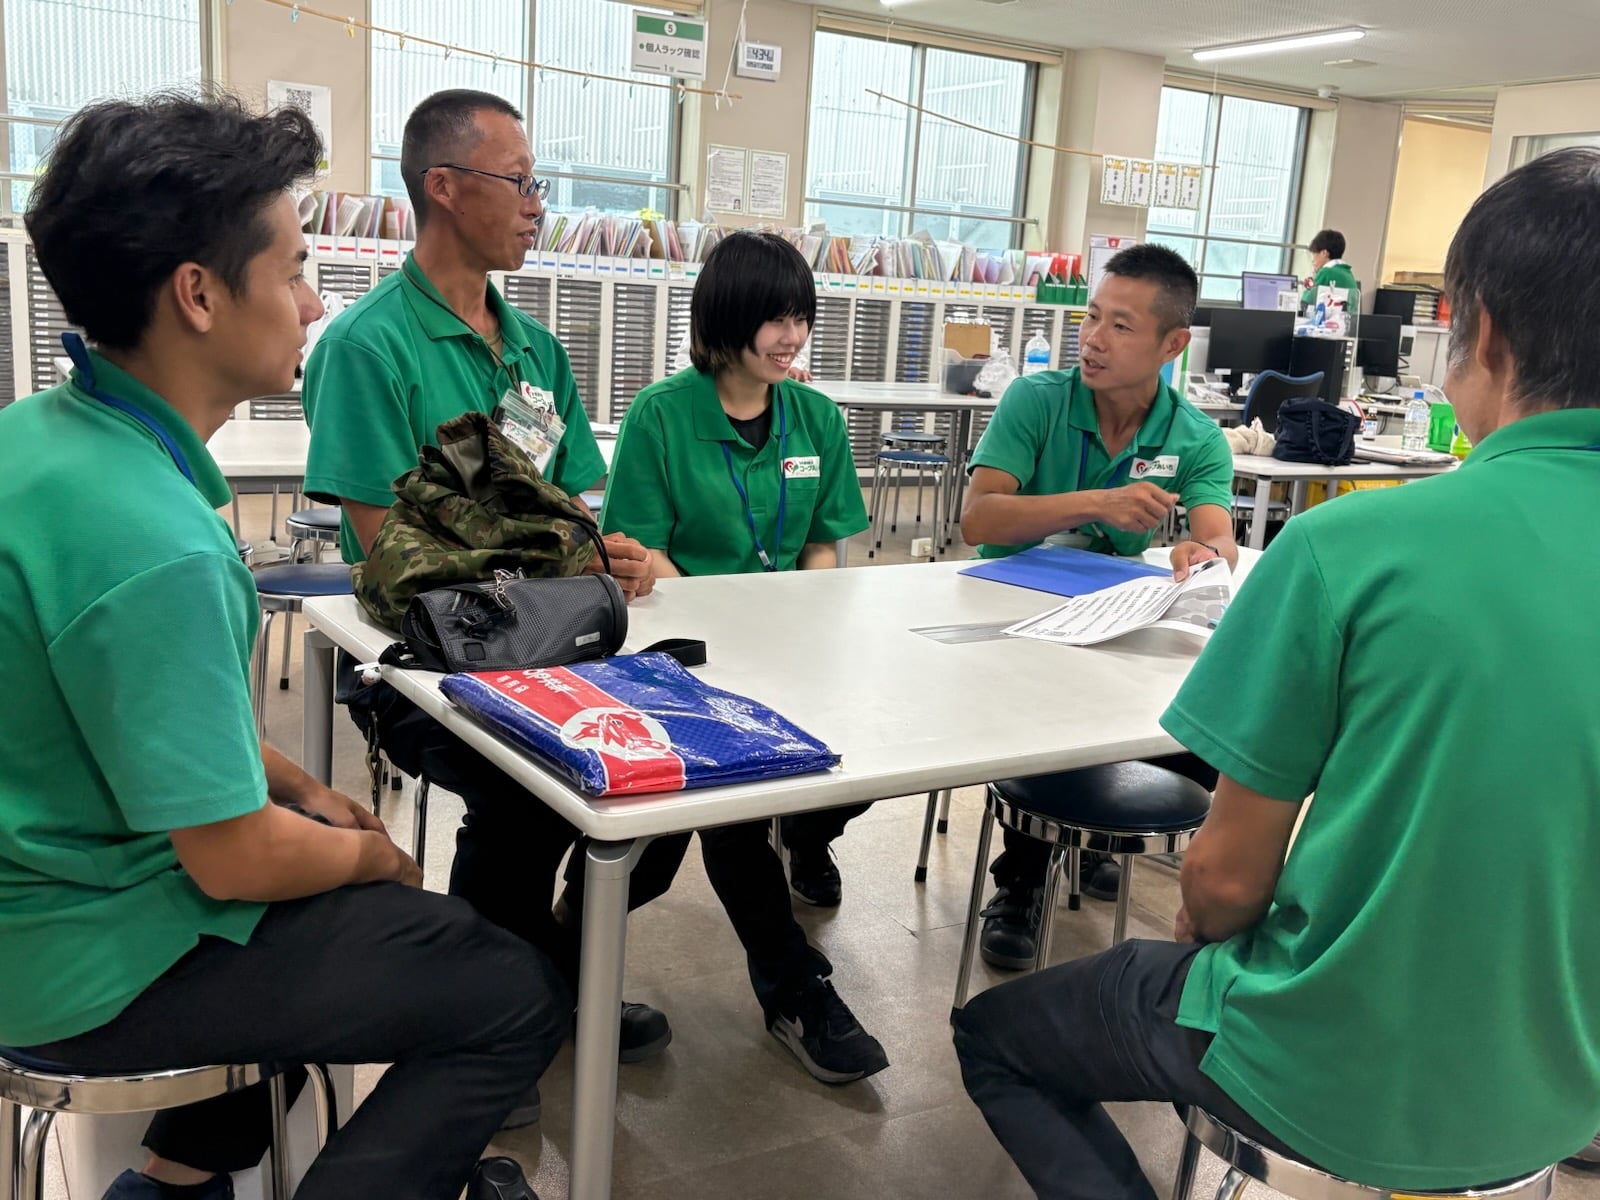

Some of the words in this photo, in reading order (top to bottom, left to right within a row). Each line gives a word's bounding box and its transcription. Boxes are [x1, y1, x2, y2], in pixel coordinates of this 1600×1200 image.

[667, 24, 673, 33] 5
[645, 42, 701, 59] 個人ラック確認
